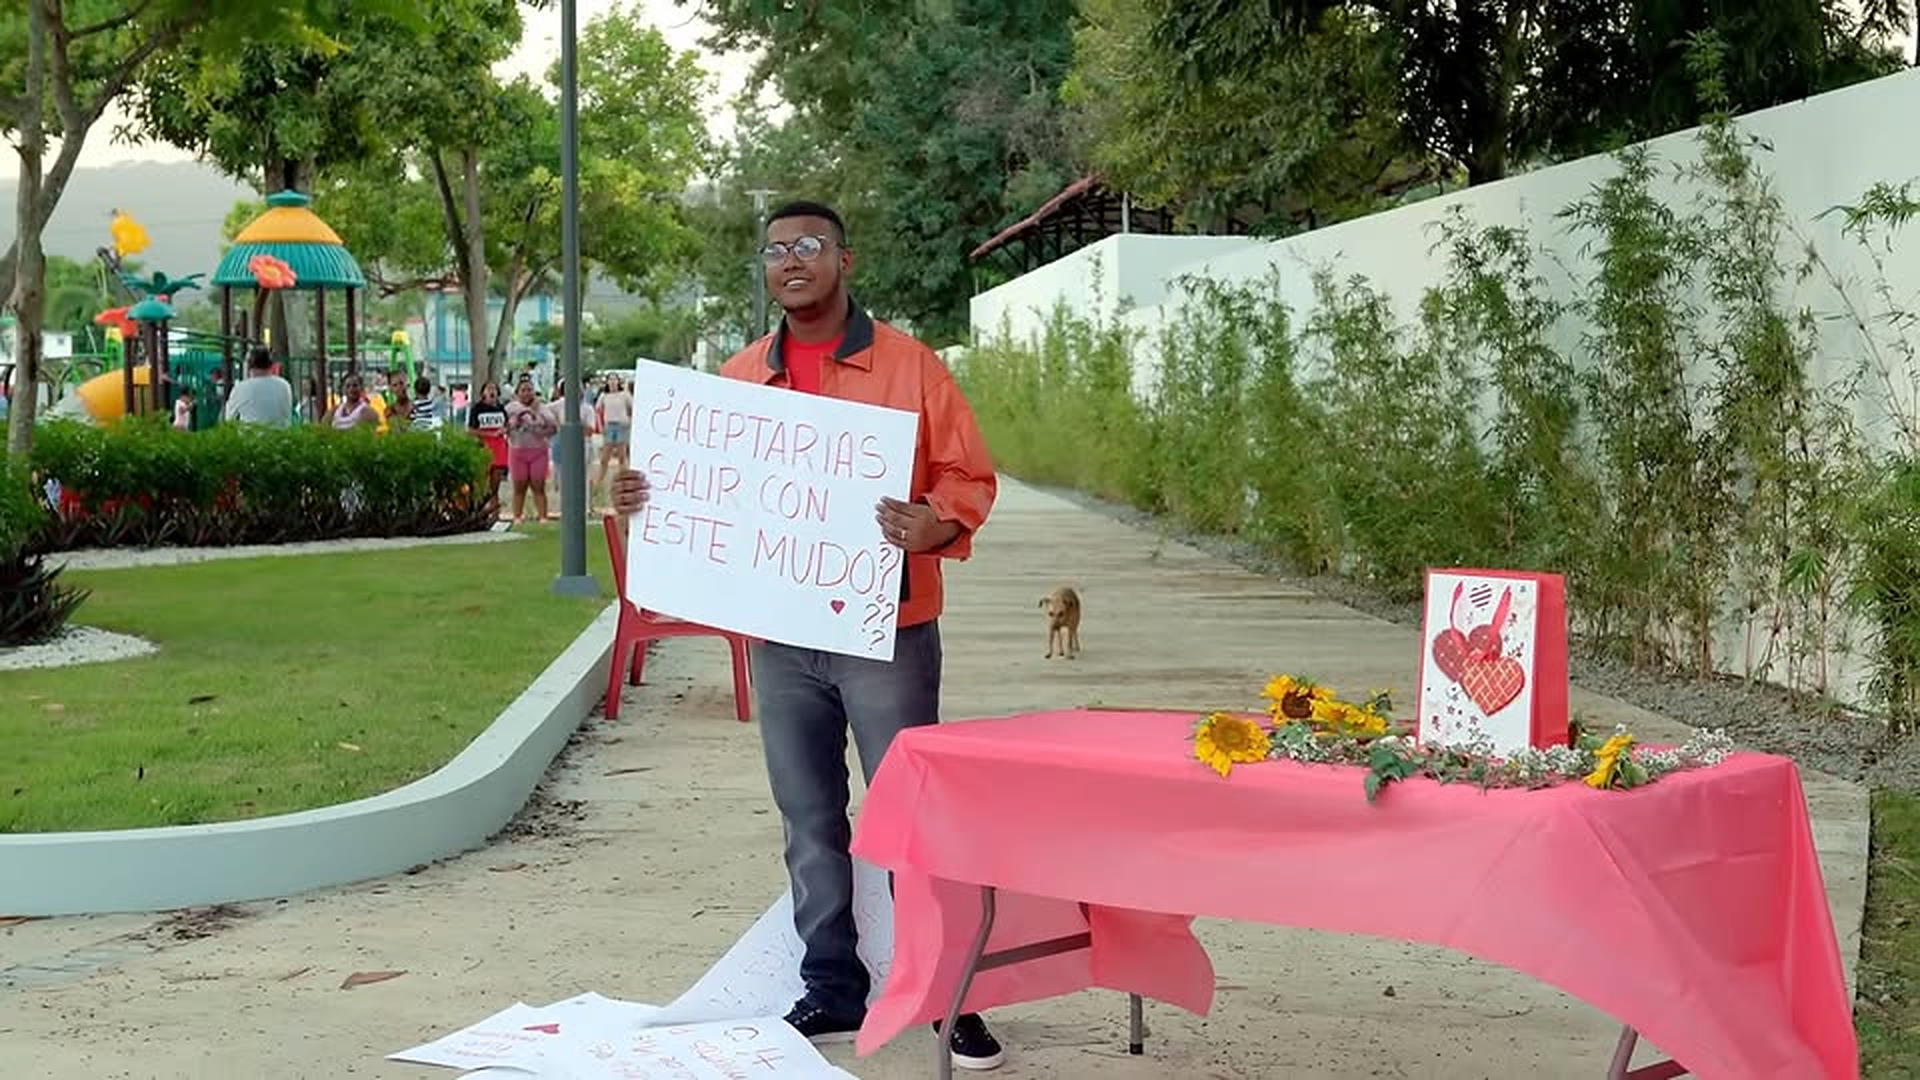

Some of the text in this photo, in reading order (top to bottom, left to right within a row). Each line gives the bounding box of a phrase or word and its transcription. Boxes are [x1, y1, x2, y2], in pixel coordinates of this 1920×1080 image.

[651, 388, 887, 480] ¿ACEPTARIAS
[649, 452, 830, 523] SALIR CON
[642, 505, 734, 565] ESTE
